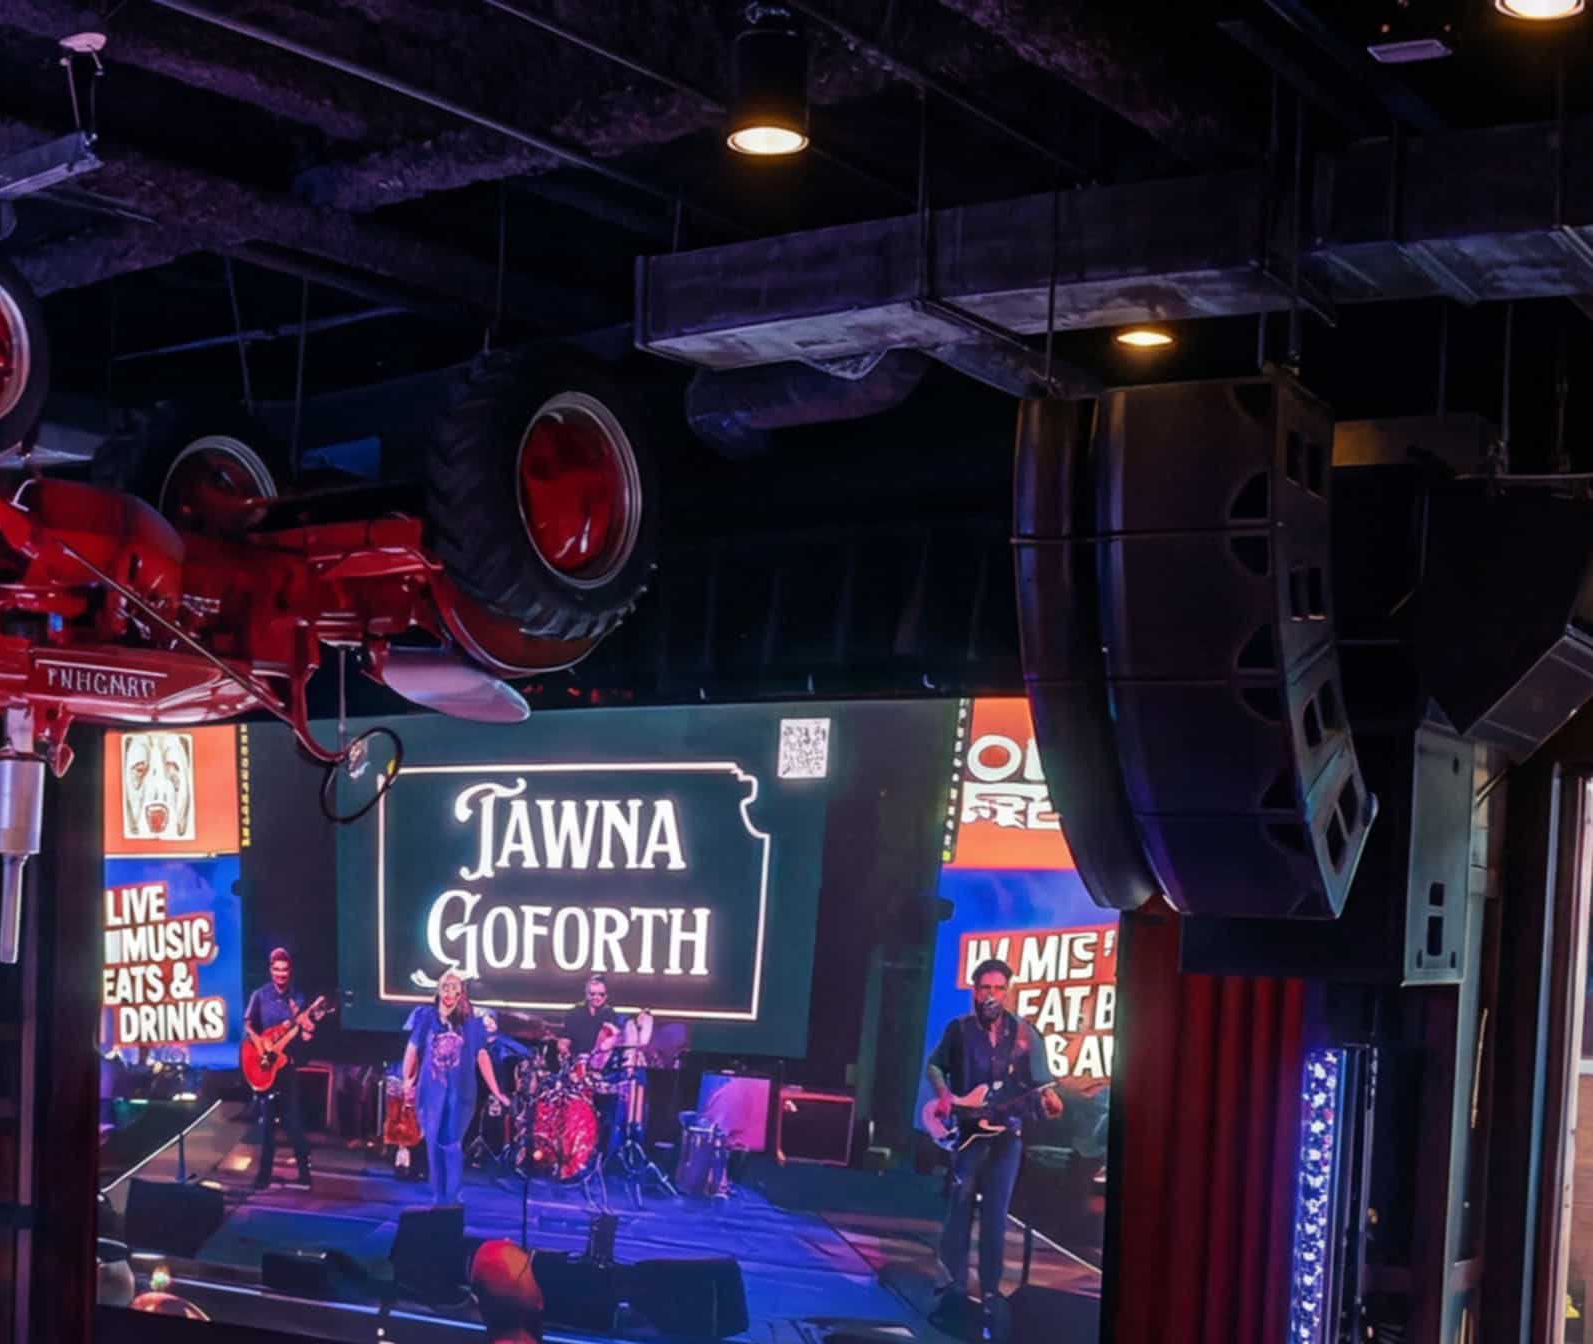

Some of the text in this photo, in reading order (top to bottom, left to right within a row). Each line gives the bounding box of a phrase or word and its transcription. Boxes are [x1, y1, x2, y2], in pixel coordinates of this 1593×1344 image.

[454, 777, 687, 881] TAWNA
[105, 885, 166, 926] LIVE
[410, 889, 711, 988] GOFORTH
[103, 962, 195, 1005] EATS &
[118, 1000, 225, 1043] DRINKS
